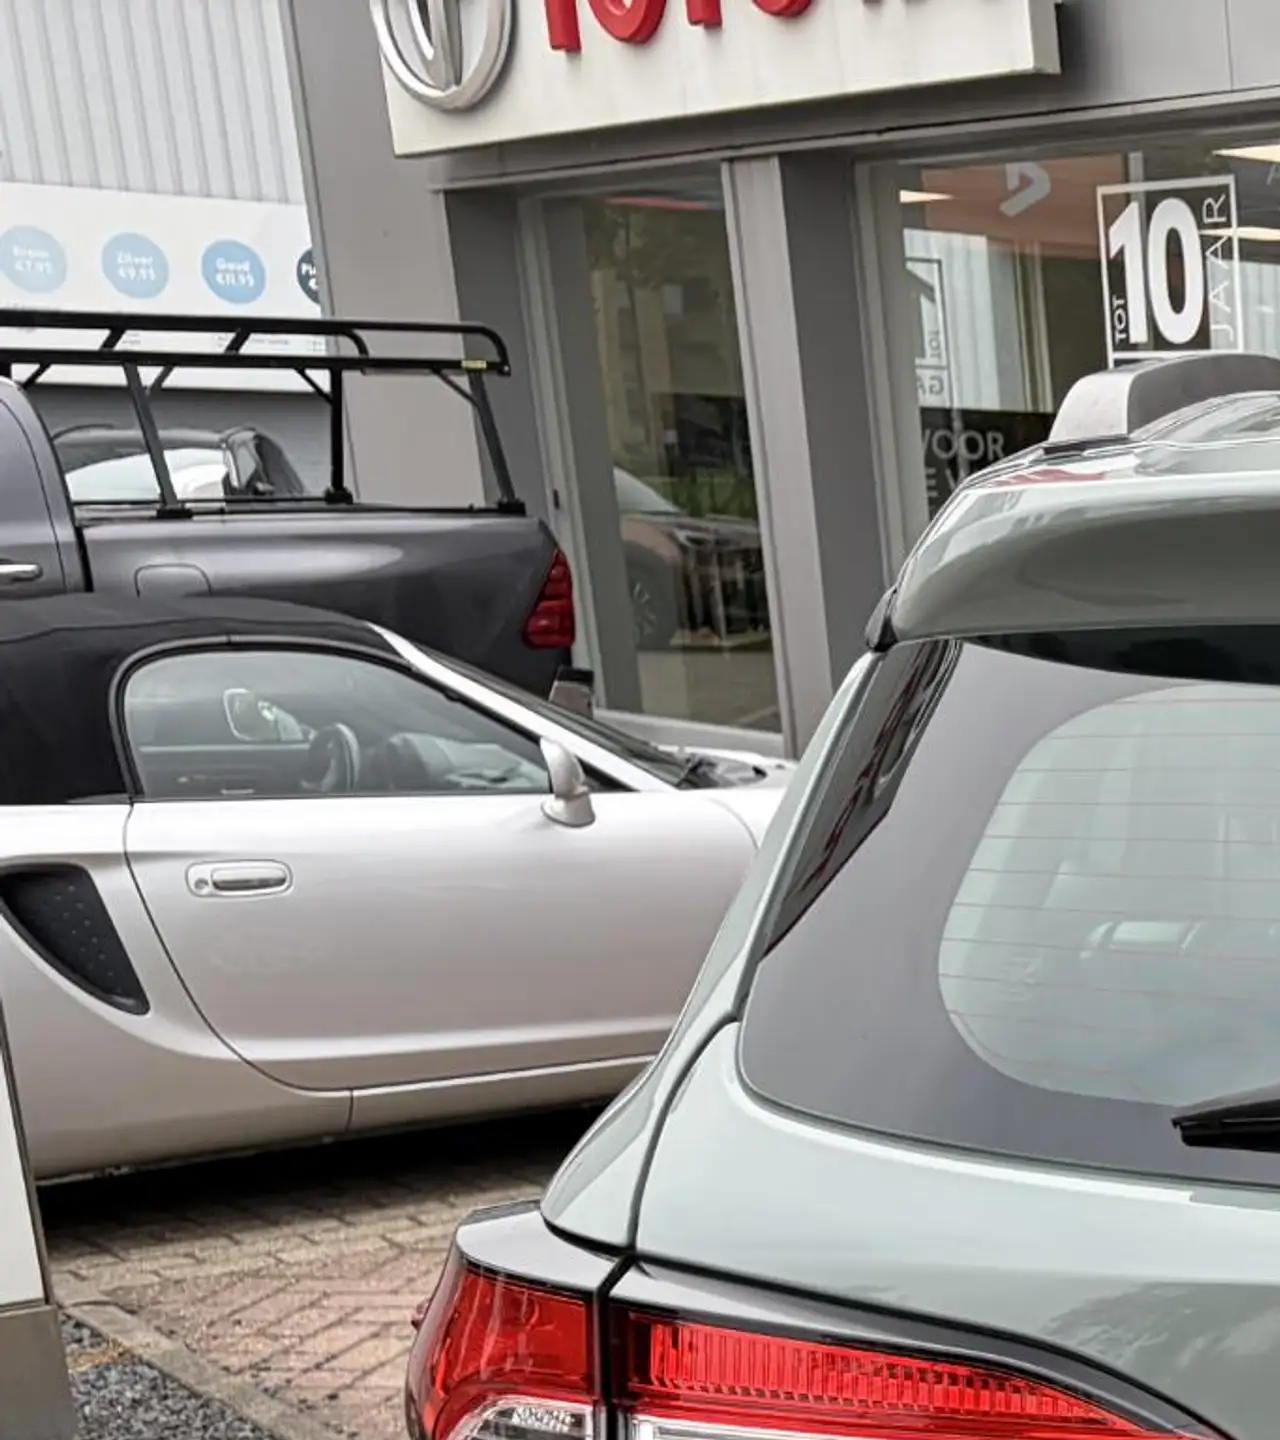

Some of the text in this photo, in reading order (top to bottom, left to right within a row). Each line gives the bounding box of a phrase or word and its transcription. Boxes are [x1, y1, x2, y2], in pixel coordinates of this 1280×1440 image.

[1108, 197, 1204, 344] 10
[1112, 295, 1127, 341] TOT
[1203, 193, 1234, 341] JAAR
